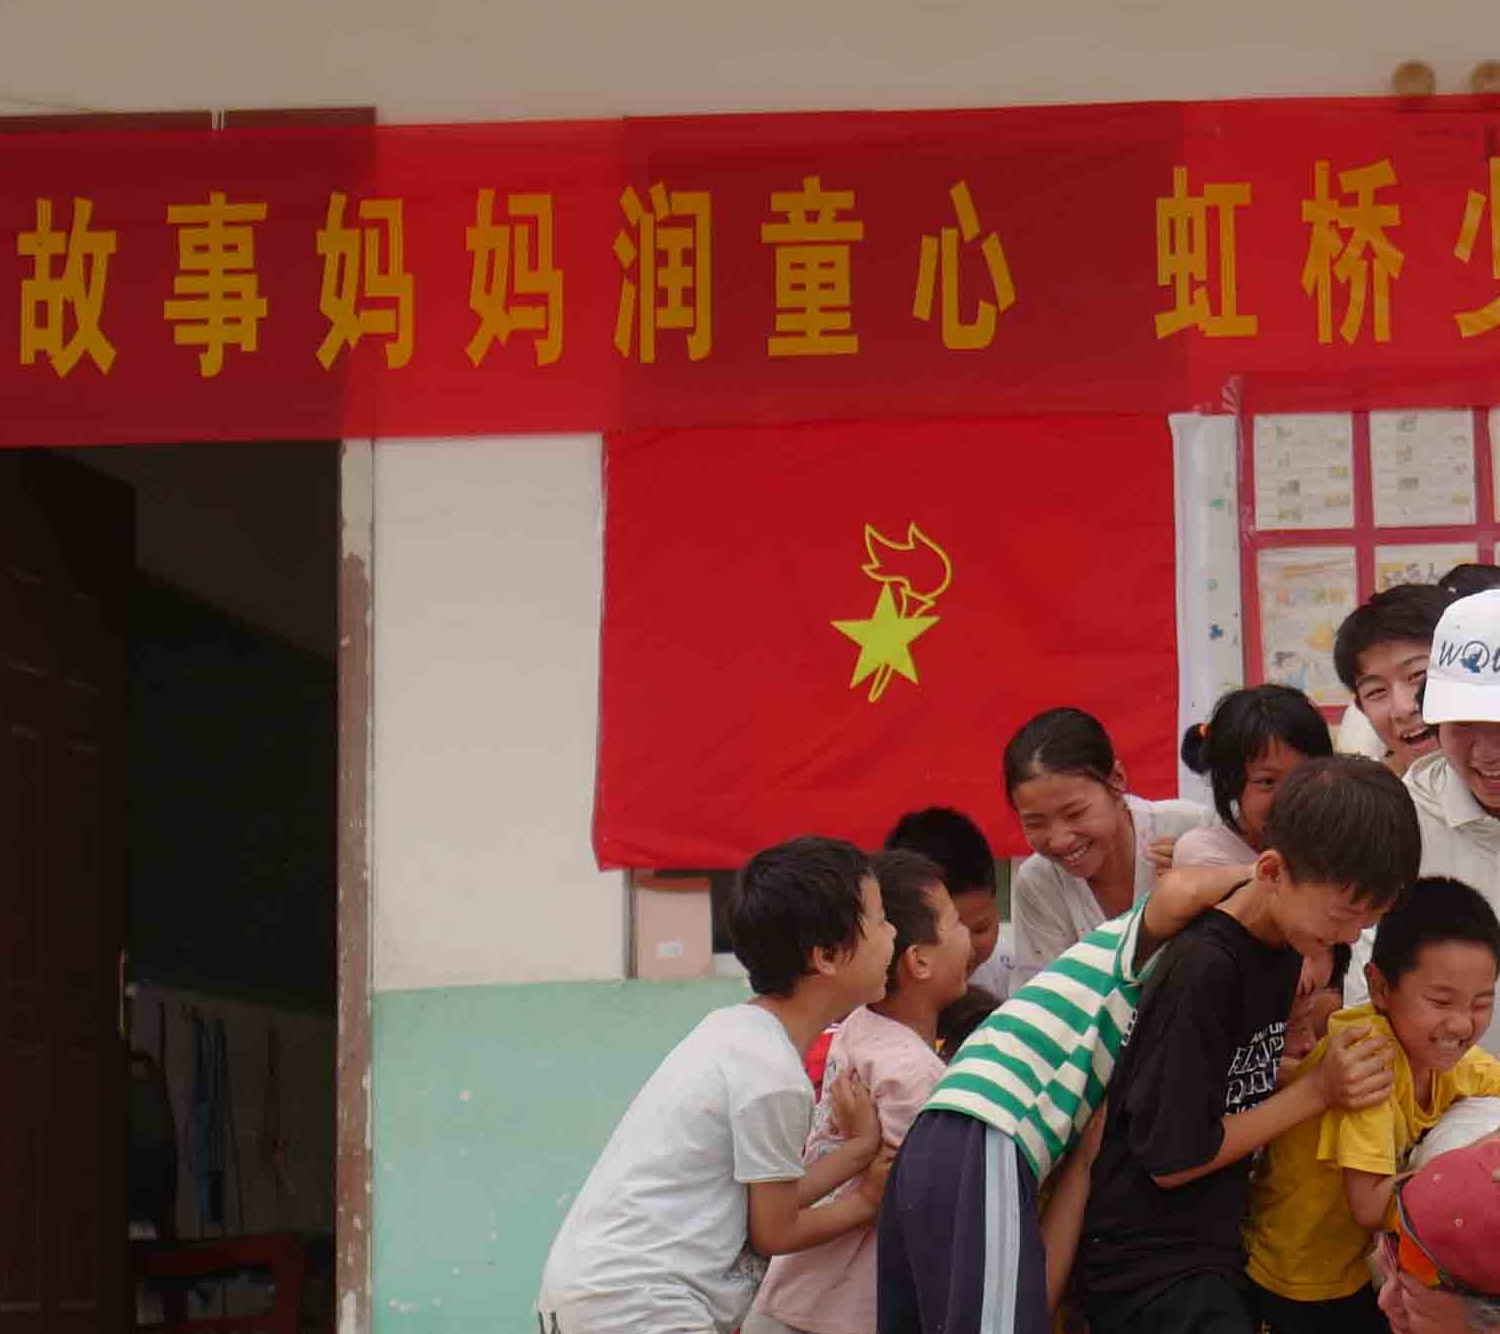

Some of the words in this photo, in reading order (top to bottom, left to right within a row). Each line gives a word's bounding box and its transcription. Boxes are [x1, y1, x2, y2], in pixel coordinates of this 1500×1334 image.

[16, 174, 1017, 378] 故事妈妈润童心
